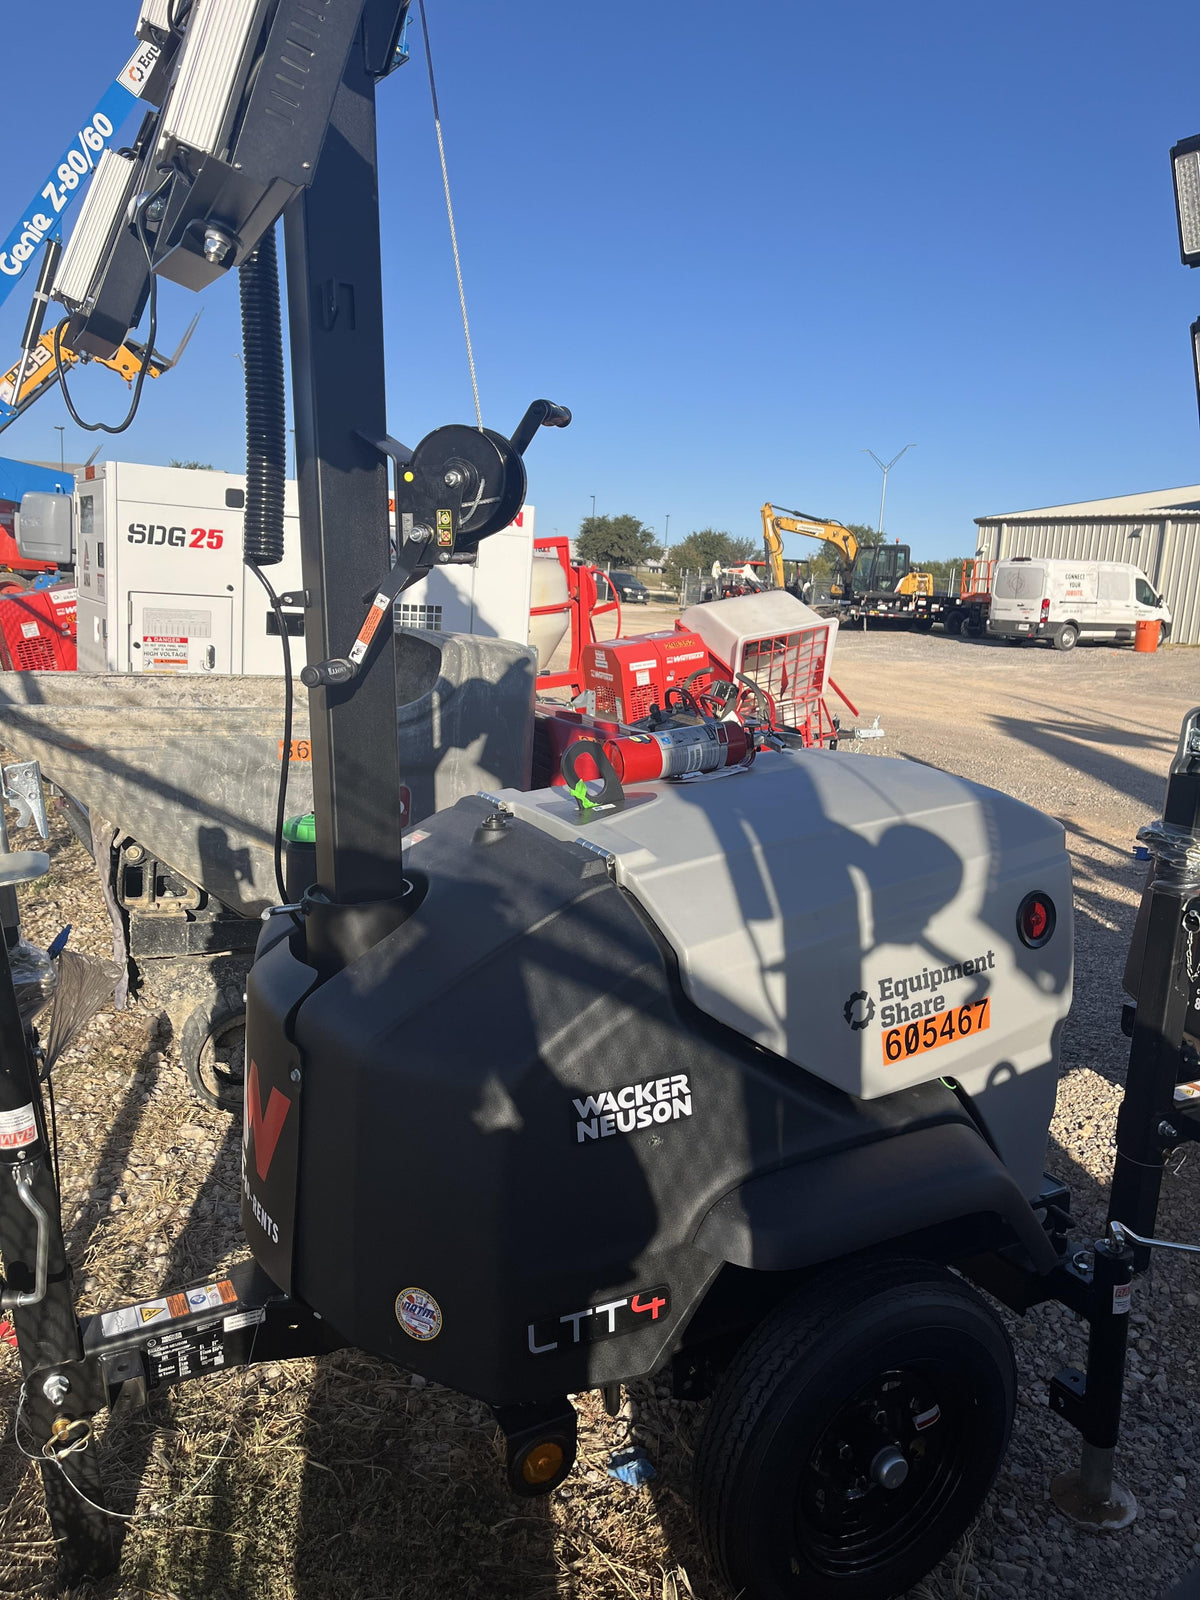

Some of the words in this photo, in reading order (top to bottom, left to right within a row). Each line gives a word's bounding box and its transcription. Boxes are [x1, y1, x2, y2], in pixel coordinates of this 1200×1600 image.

[0, 213, 54, 275] Genie
[41, 112, 113, 213] Z-80/60
[878, 950, 995, 1001] Equipment
[881, 995, 945, 1028] Share
[885, 998, 988, 1061] 605467
[572, 1074, 692, 1118] WACKER
[576, 1094, 693, 1143] NEUSON
